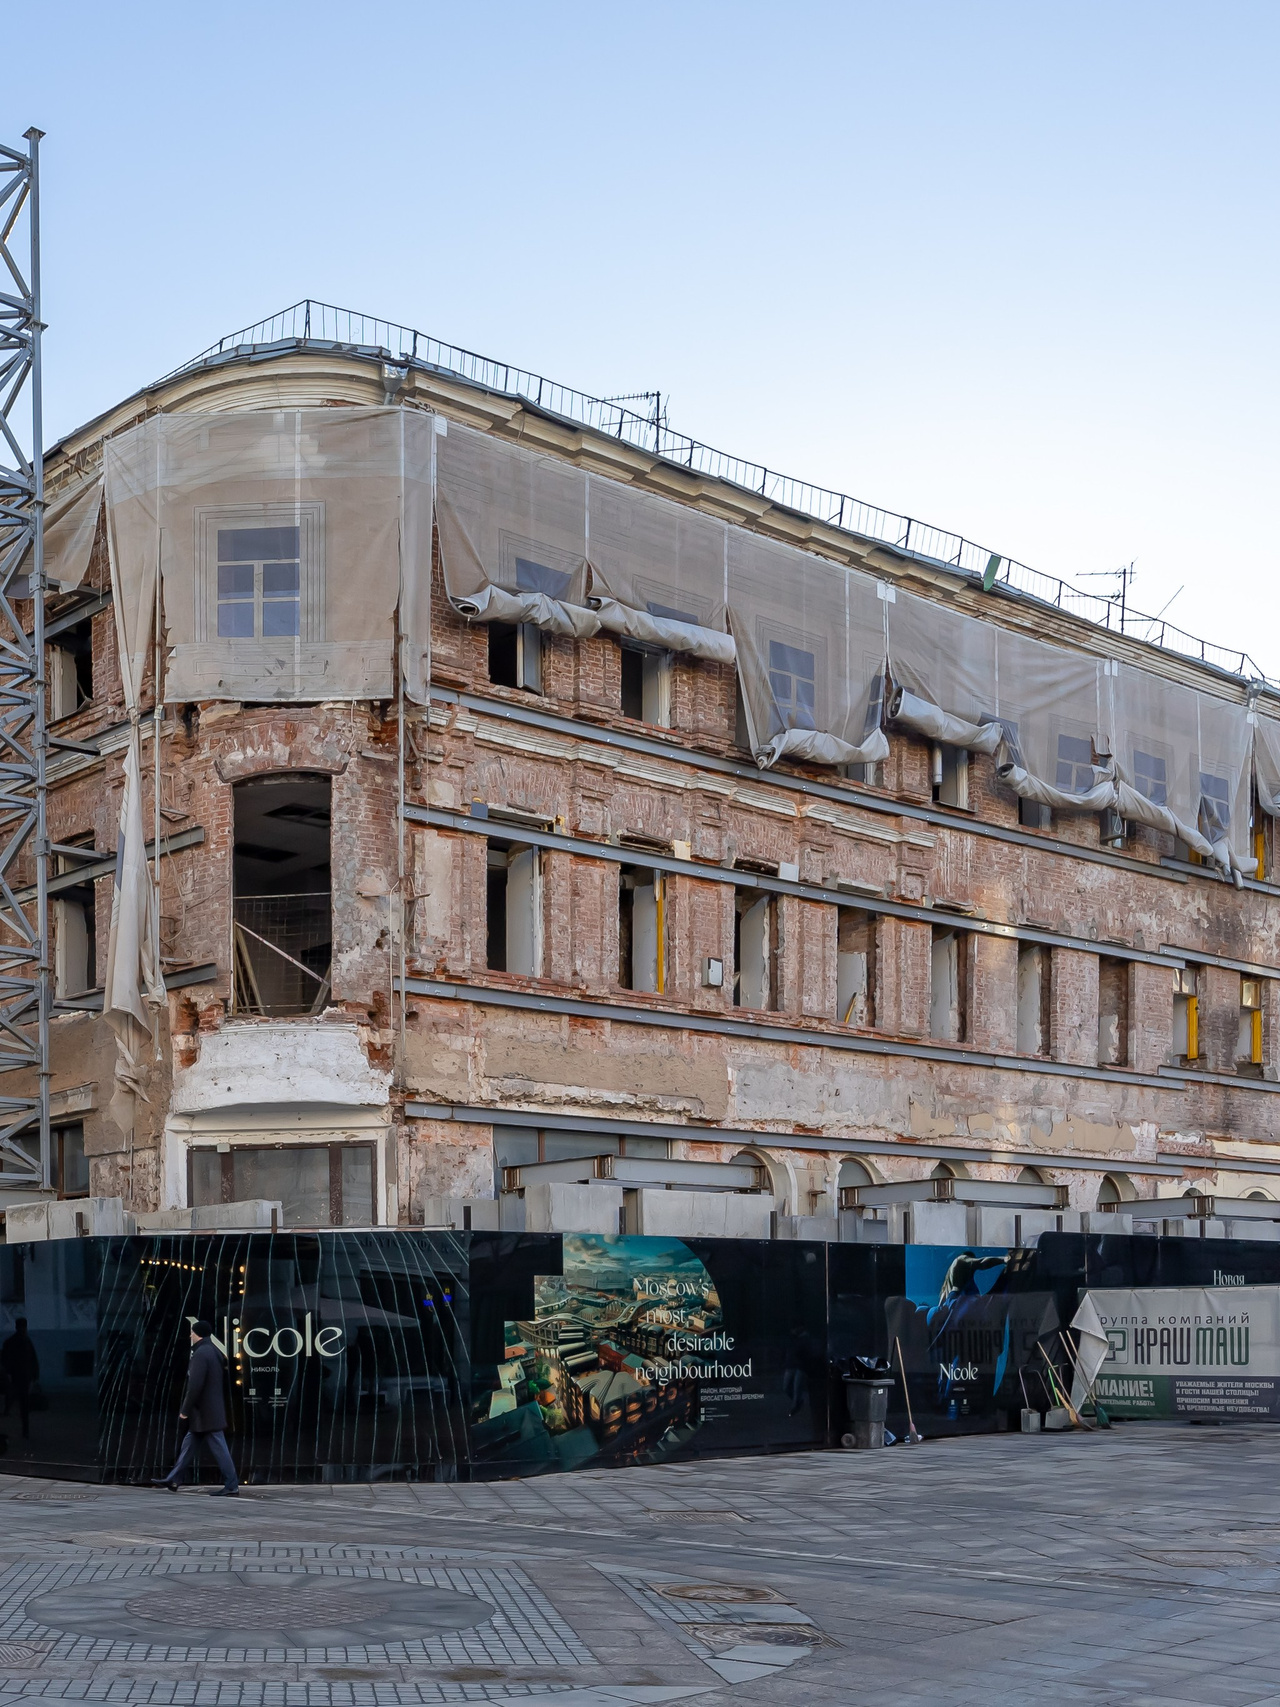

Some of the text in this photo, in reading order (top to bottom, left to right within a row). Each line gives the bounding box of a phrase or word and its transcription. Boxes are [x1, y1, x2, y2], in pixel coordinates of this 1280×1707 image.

[633, 1277, 709, 1296] Moscow's
[1213, 1270, 1245, 1286] Новая
[646, 1309, 686, 1324] most
[1097, 1312, 1250, 1327] руппа компаний
[667, 1331, 735, 1351] desirable
[1134, 1326, 1250, 1366] КРАШМАШ
[635, 1358, 752, 1385] neighbourhood
[939, 1362, 979, 1380] Nicole
[1096, 1378, 1154, 1398] МАНИЕ!
